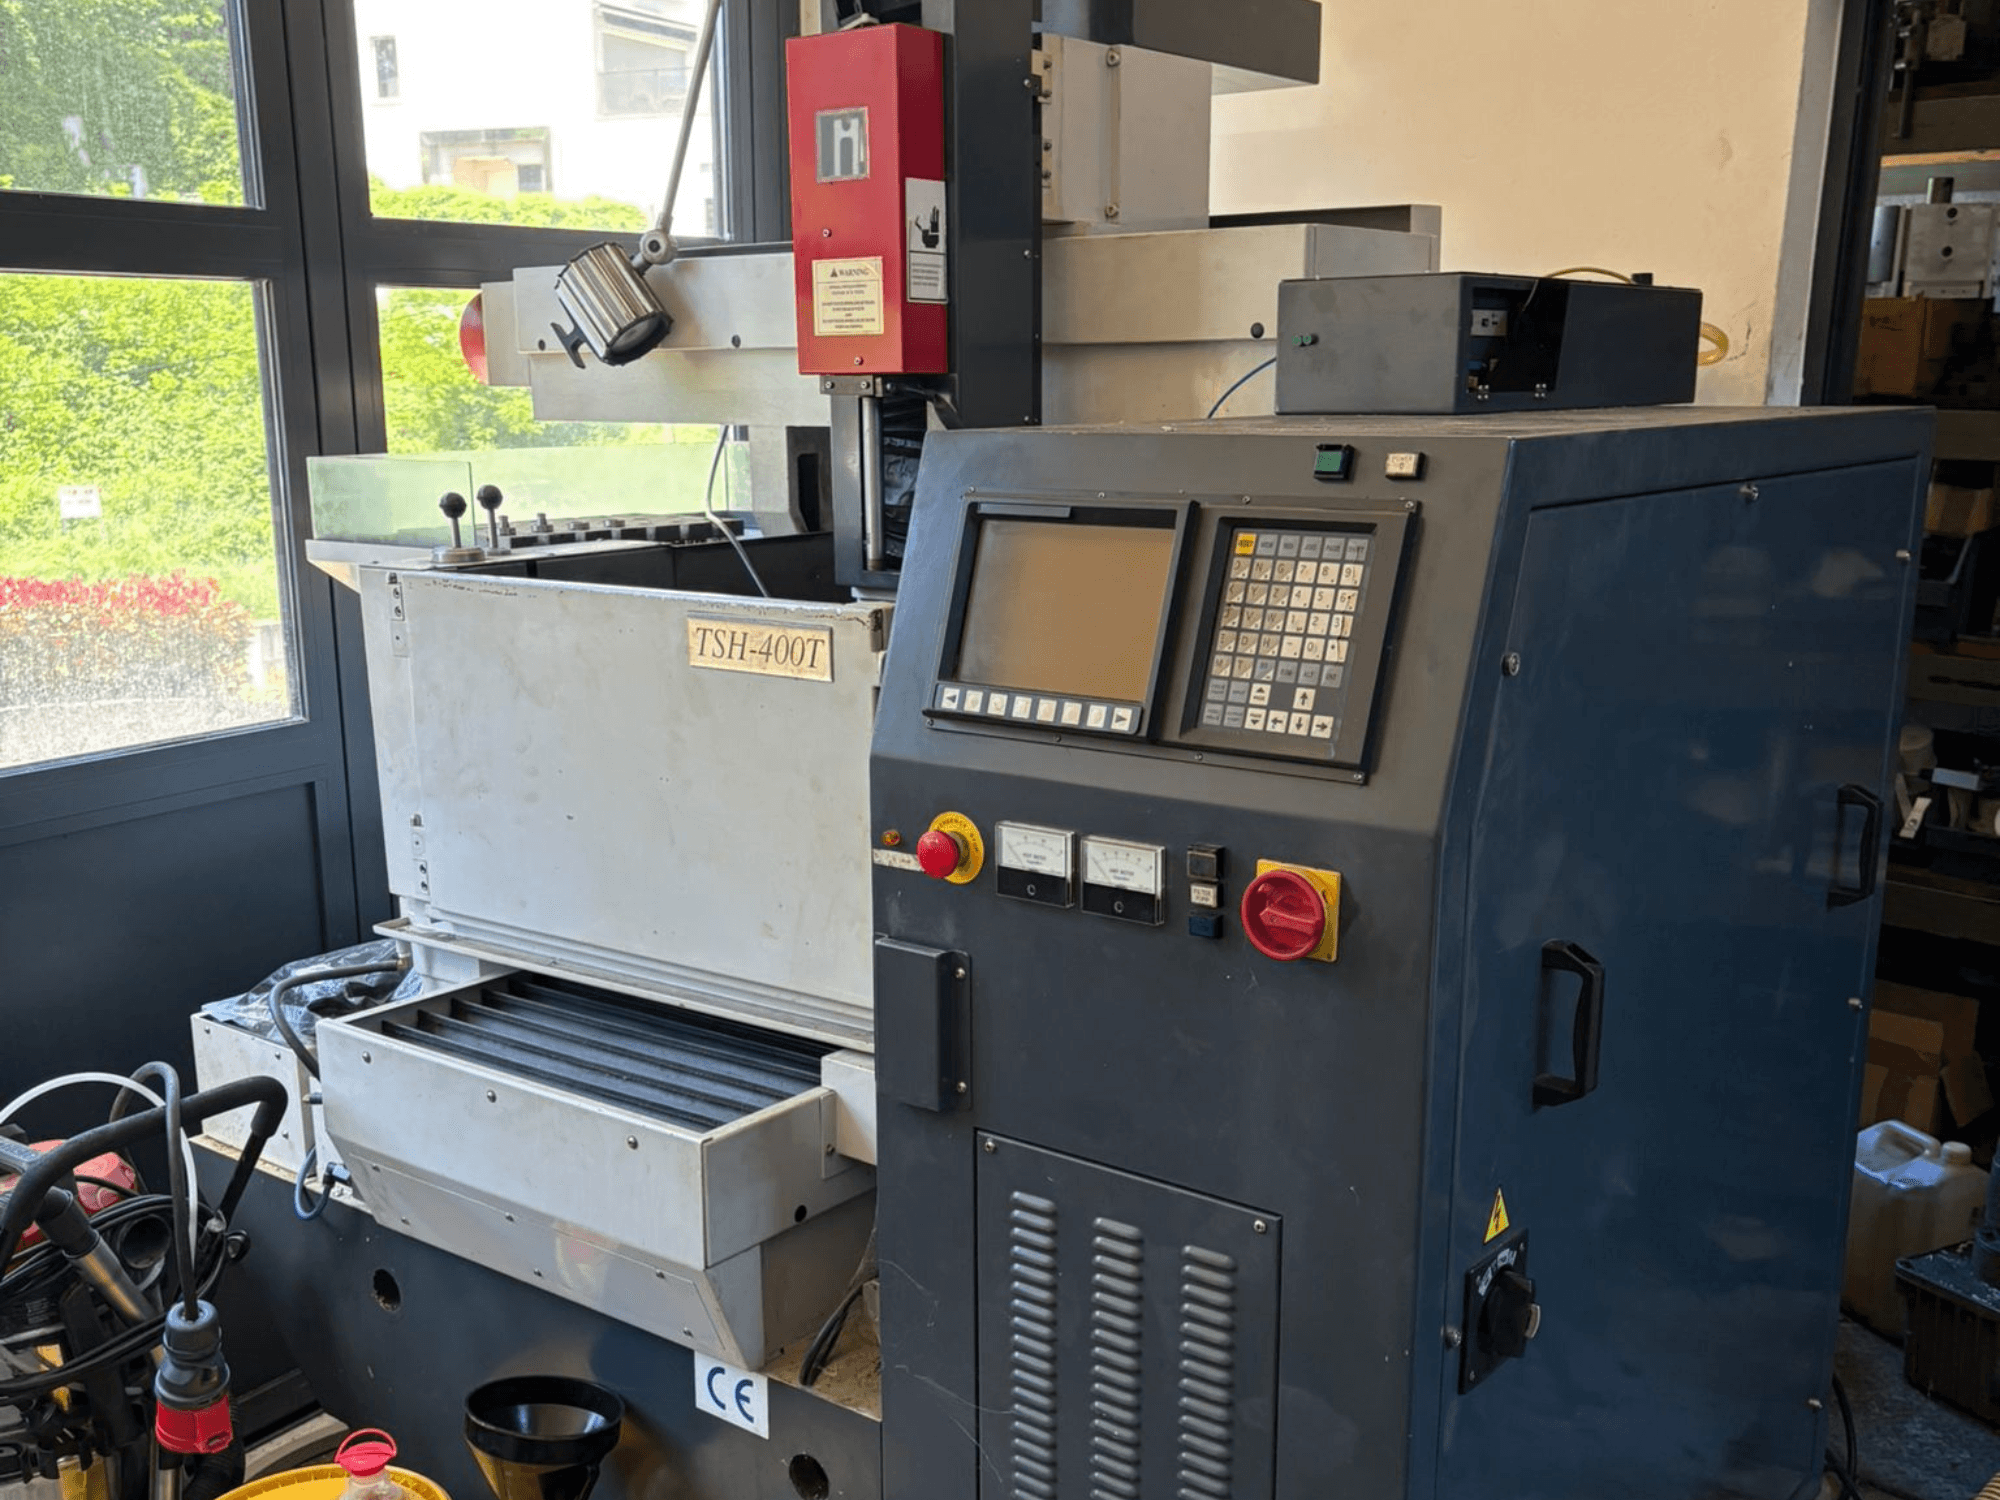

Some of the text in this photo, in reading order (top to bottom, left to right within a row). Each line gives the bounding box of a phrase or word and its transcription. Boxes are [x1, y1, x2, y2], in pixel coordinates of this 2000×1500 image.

[838, 268, 869, 277] WARNING
[1300, 564, 1307, 575] 7
[1322, 565, 1329, 577] 8
[1344, 567, 1352, 578] 9
[1294, 590, 1302, 600] 4
[1317, 590, 1324, 602] 5
[1339, 592, 1346, 603] 6
[1246, 611, 1254, 621] V
[1312, 616, 1319, 627] 2
[1334, 617, 1340, 628] 3
[696, 627, 825, 669] TSH-400T
[1241, 636, 1249, 646] D
[707, 1366, 754, 1424] CE
